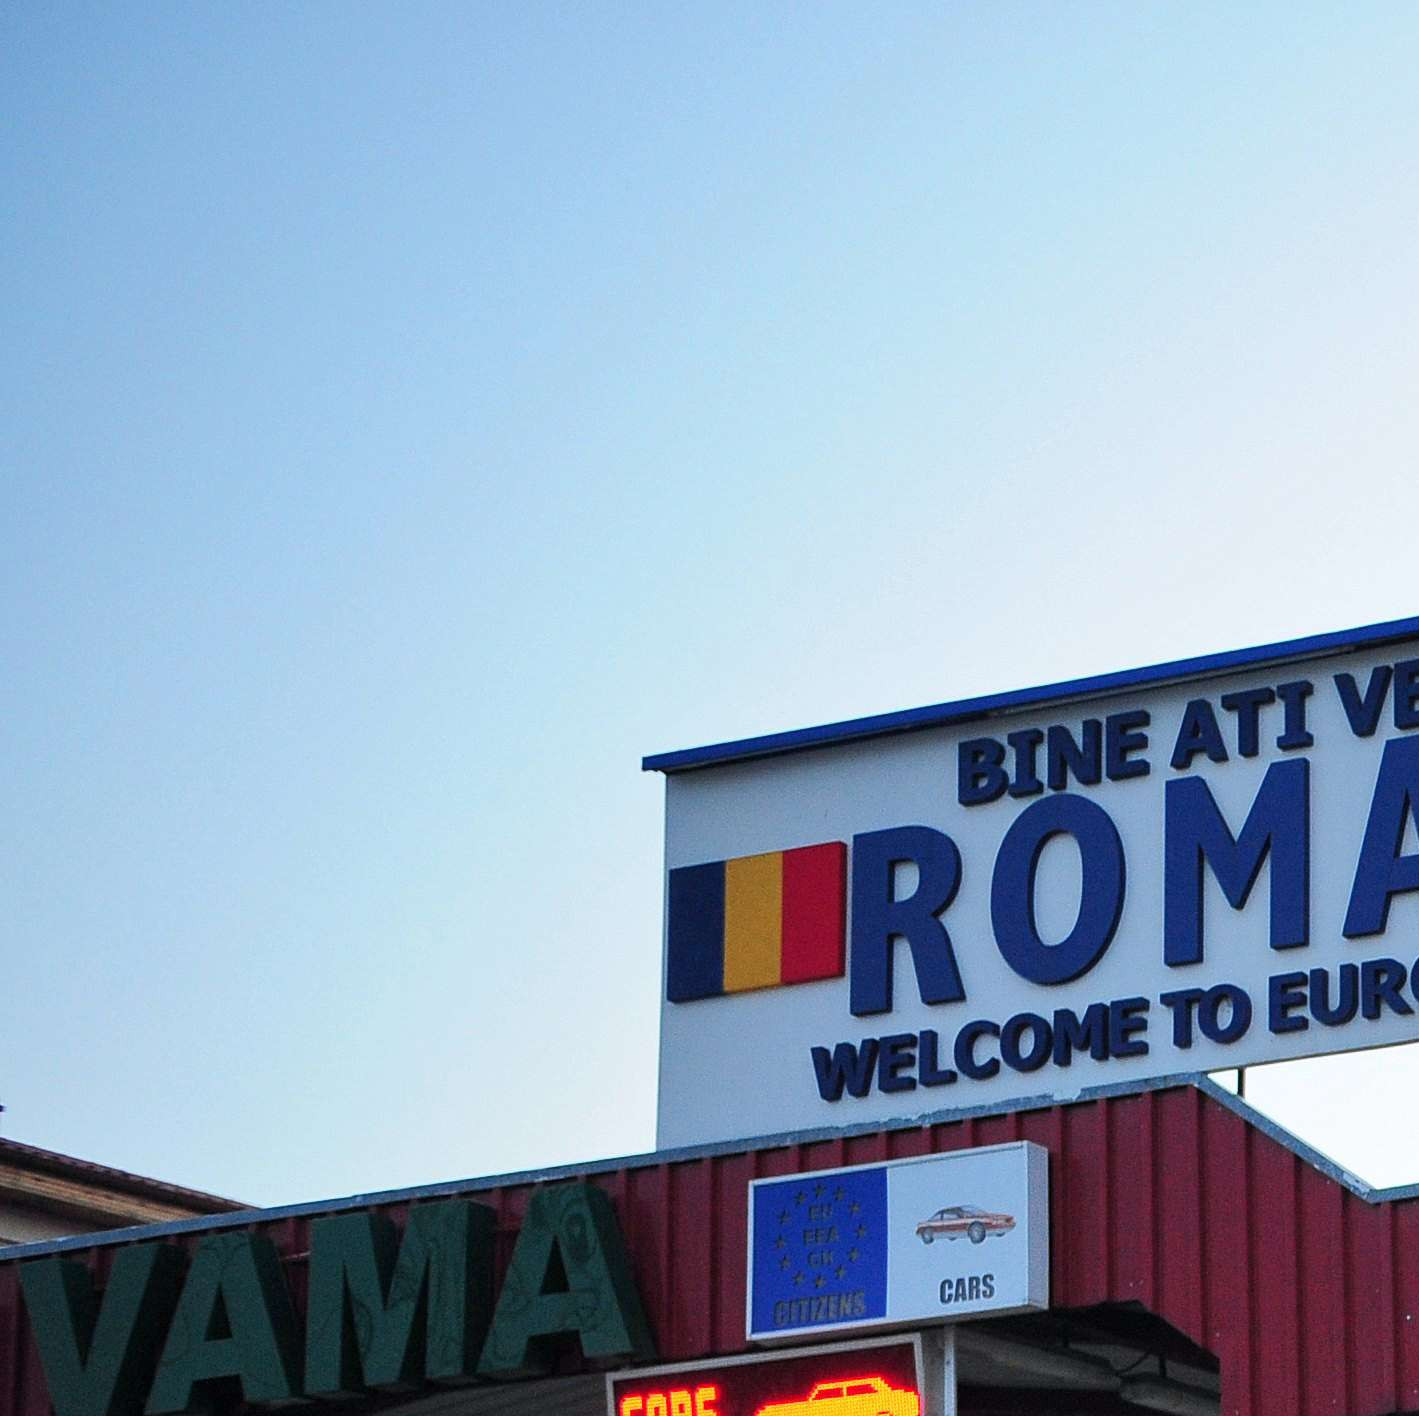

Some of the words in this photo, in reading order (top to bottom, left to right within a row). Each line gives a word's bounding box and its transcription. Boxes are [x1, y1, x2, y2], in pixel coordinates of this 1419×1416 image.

[958, 709, 1151, 806] BINE
[1170, 681, 1315, 769] ATI
[810, 998, 1150, 1102] WELCOME
[1159, 983, 1252, 1049] TO
[773, 1290, 866, 1326] CITIZENS
[940, 1273, 995, 1305] CARS
